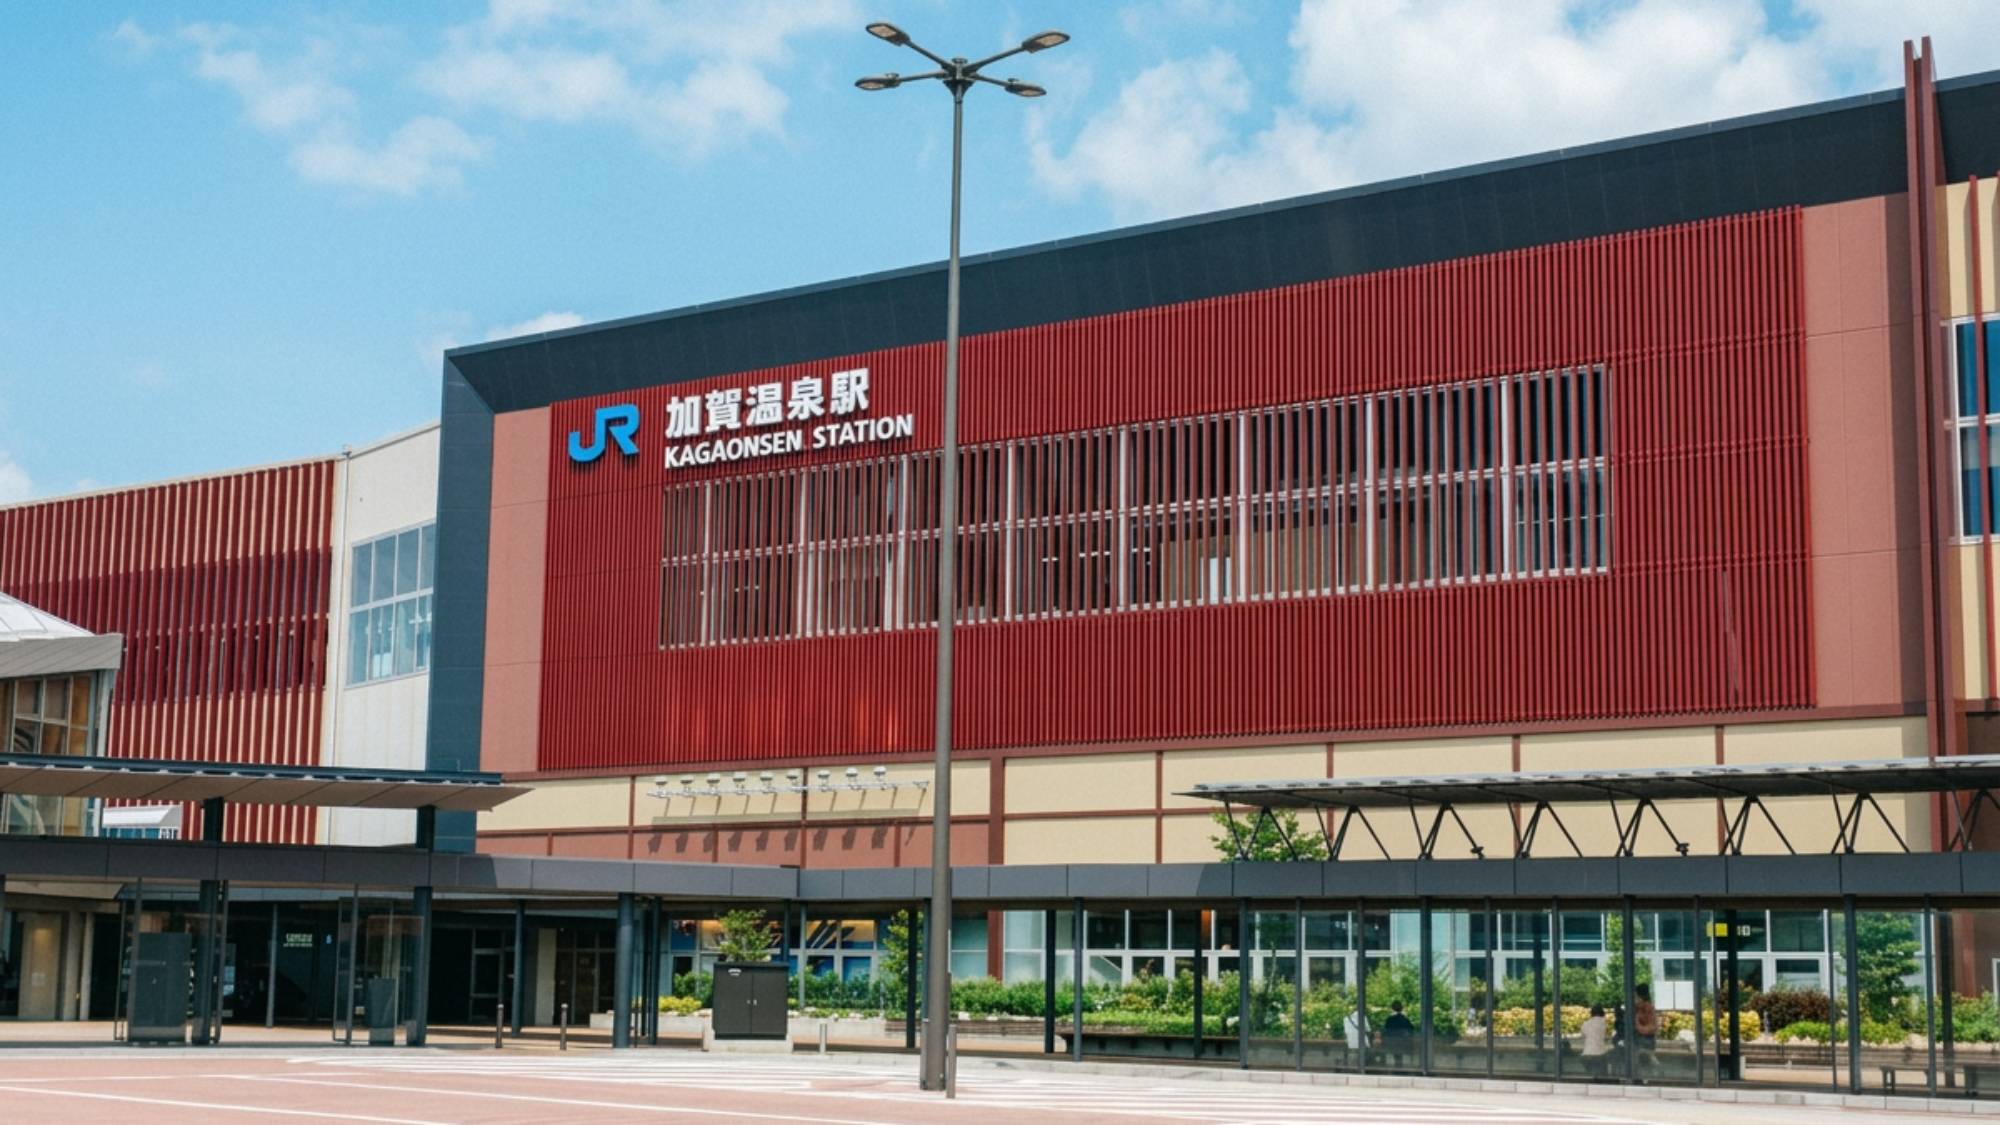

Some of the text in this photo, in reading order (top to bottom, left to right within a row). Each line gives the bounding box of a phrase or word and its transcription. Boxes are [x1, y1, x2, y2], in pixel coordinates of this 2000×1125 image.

[568, 403, 640, 463] JR
[665, 367, 870, 439] 加賀温泉駅
[664, 413, 914, 469] KAGAONSEN STATION
